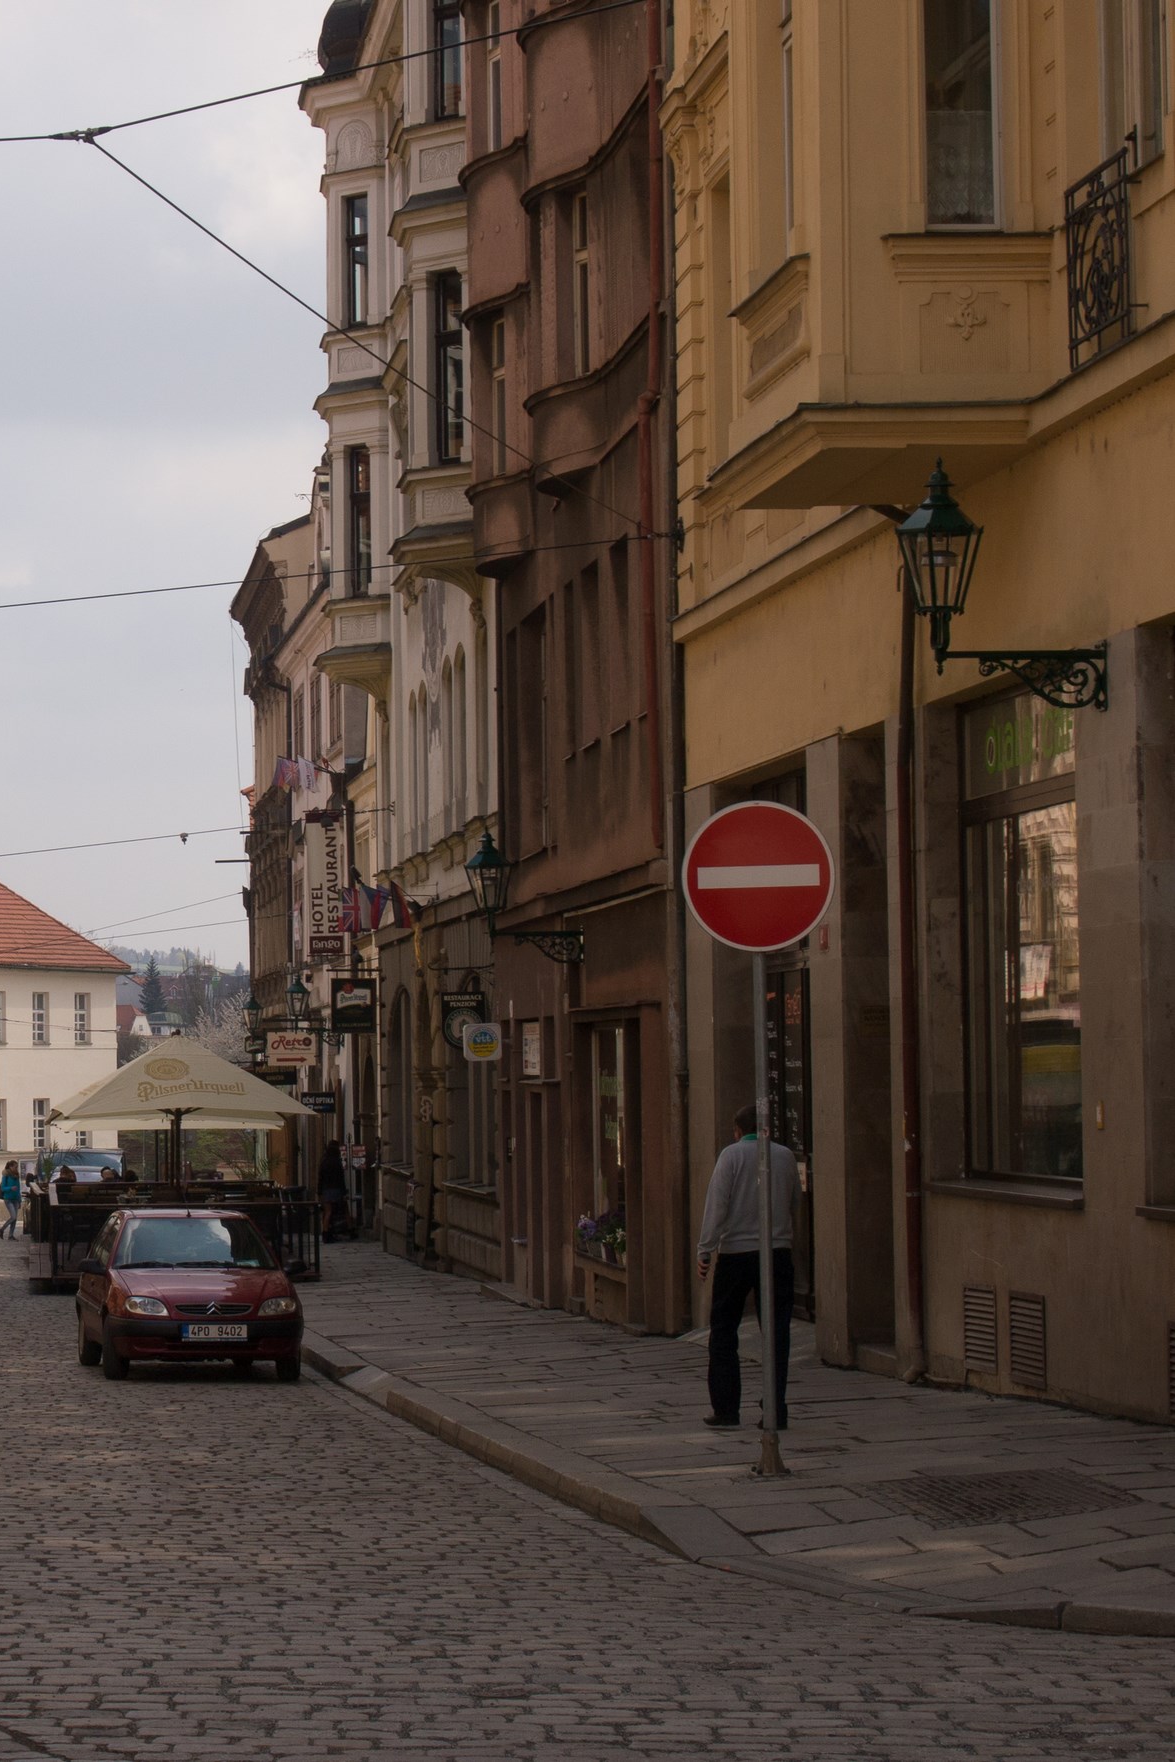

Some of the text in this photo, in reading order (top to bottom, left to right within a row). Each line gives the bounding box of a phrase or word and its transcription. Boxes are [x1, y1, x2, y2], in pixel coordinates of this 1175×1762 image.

[325, 825, 340, 934] RESTAURANT
[311, 883, 324, 934] HOTEL
[137, 1079, 245, 1103] Pilsner Urquell
[316, 1096, 334, 1104] OPTIKA
[217, 1326, 243, 1337] 9402
